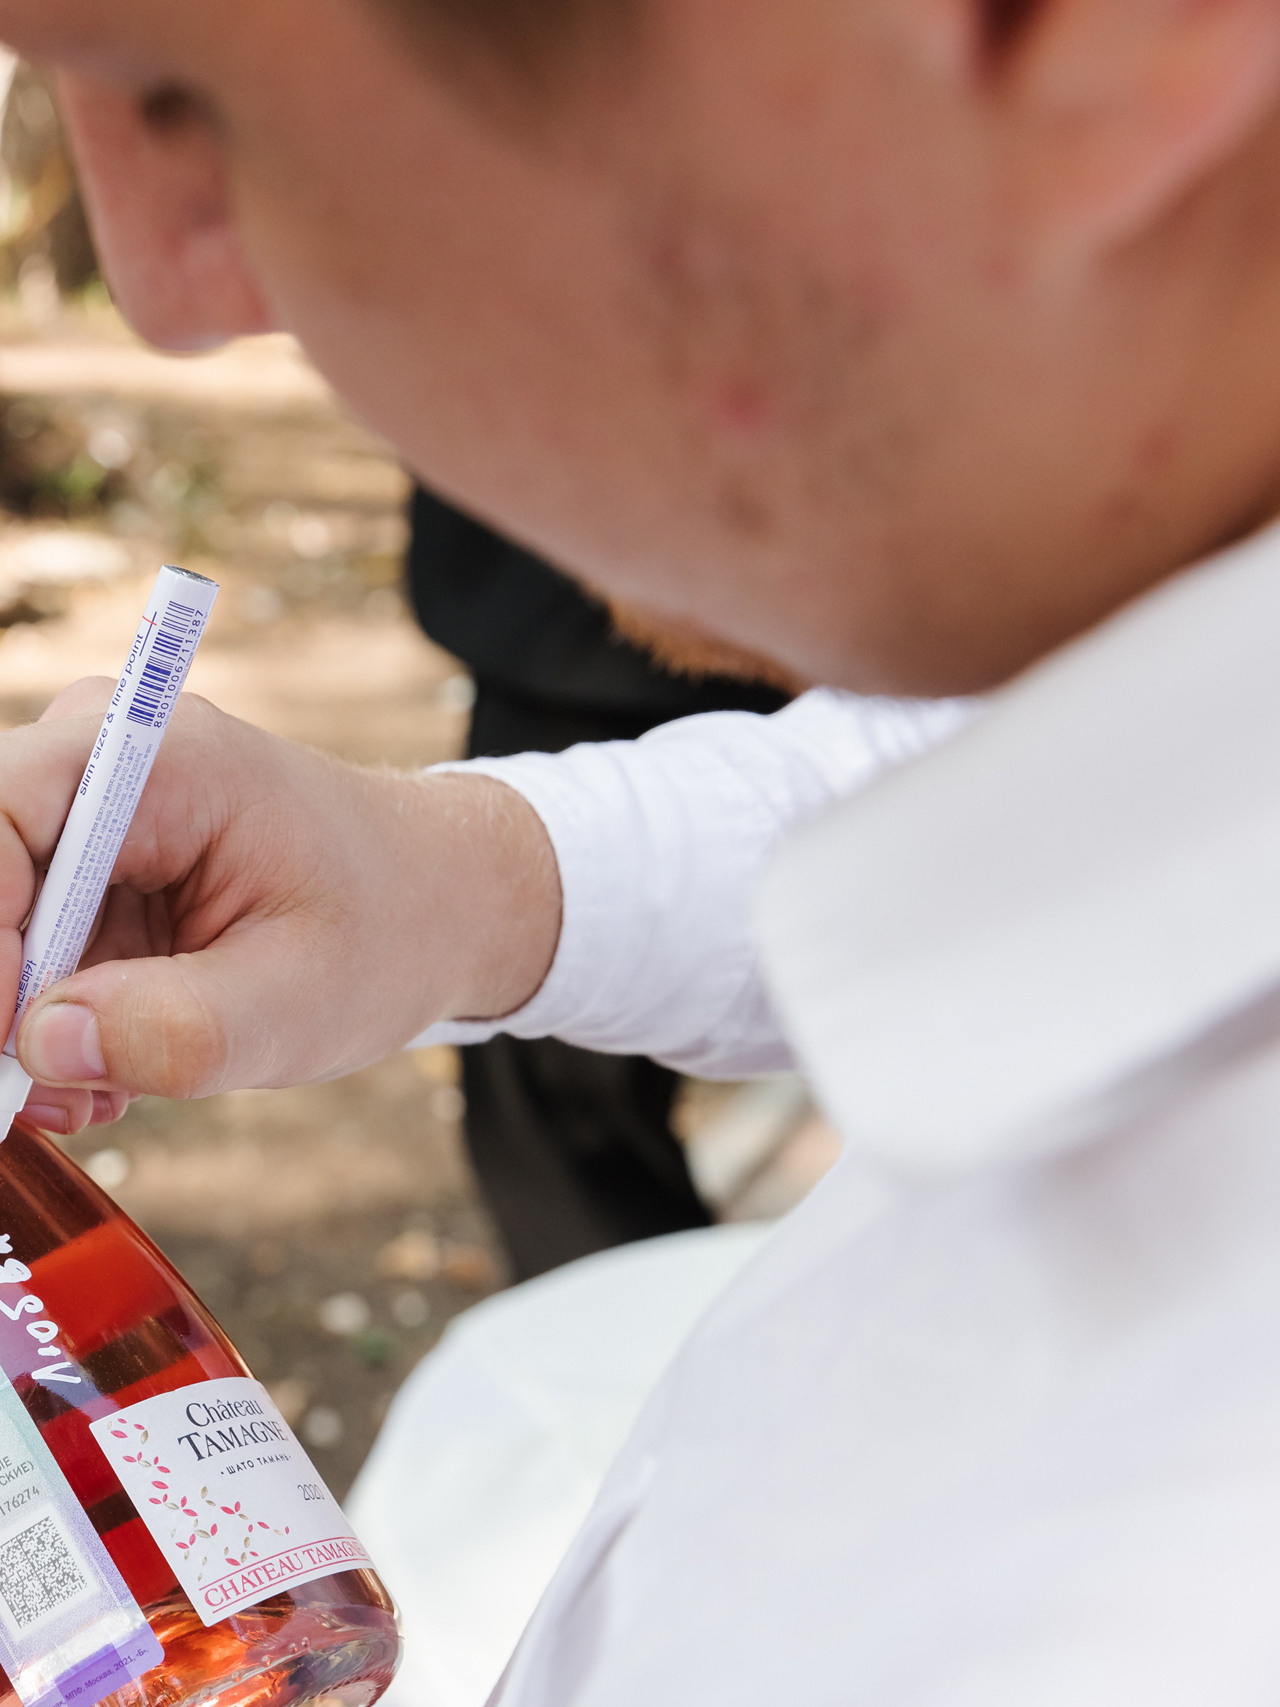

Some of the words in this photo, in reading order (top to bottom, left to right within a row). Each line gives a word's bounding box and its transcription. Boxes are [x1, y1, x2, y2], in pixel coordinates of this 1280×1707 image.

[153, 609, 204, 728] 8801006711387
[80, 764, 96, 795] slim
[93, 728, 109, 759] size
[106, 712, 115, 723] &
[112, 678, 127, 707] fine
[125, 633, 144, 675] point
[185, 1398, 264, 1428] Château
[177, 1420, 289, 1461] TAMAGNE
[226, 1460, 255, 1475] ШАТО
[257, 1453, 289, 1466] ТАМАНЬ
[204, 1551, 304, 1607] CHATEAU
[303, 1540, 368, 1565] TAMAGNE
